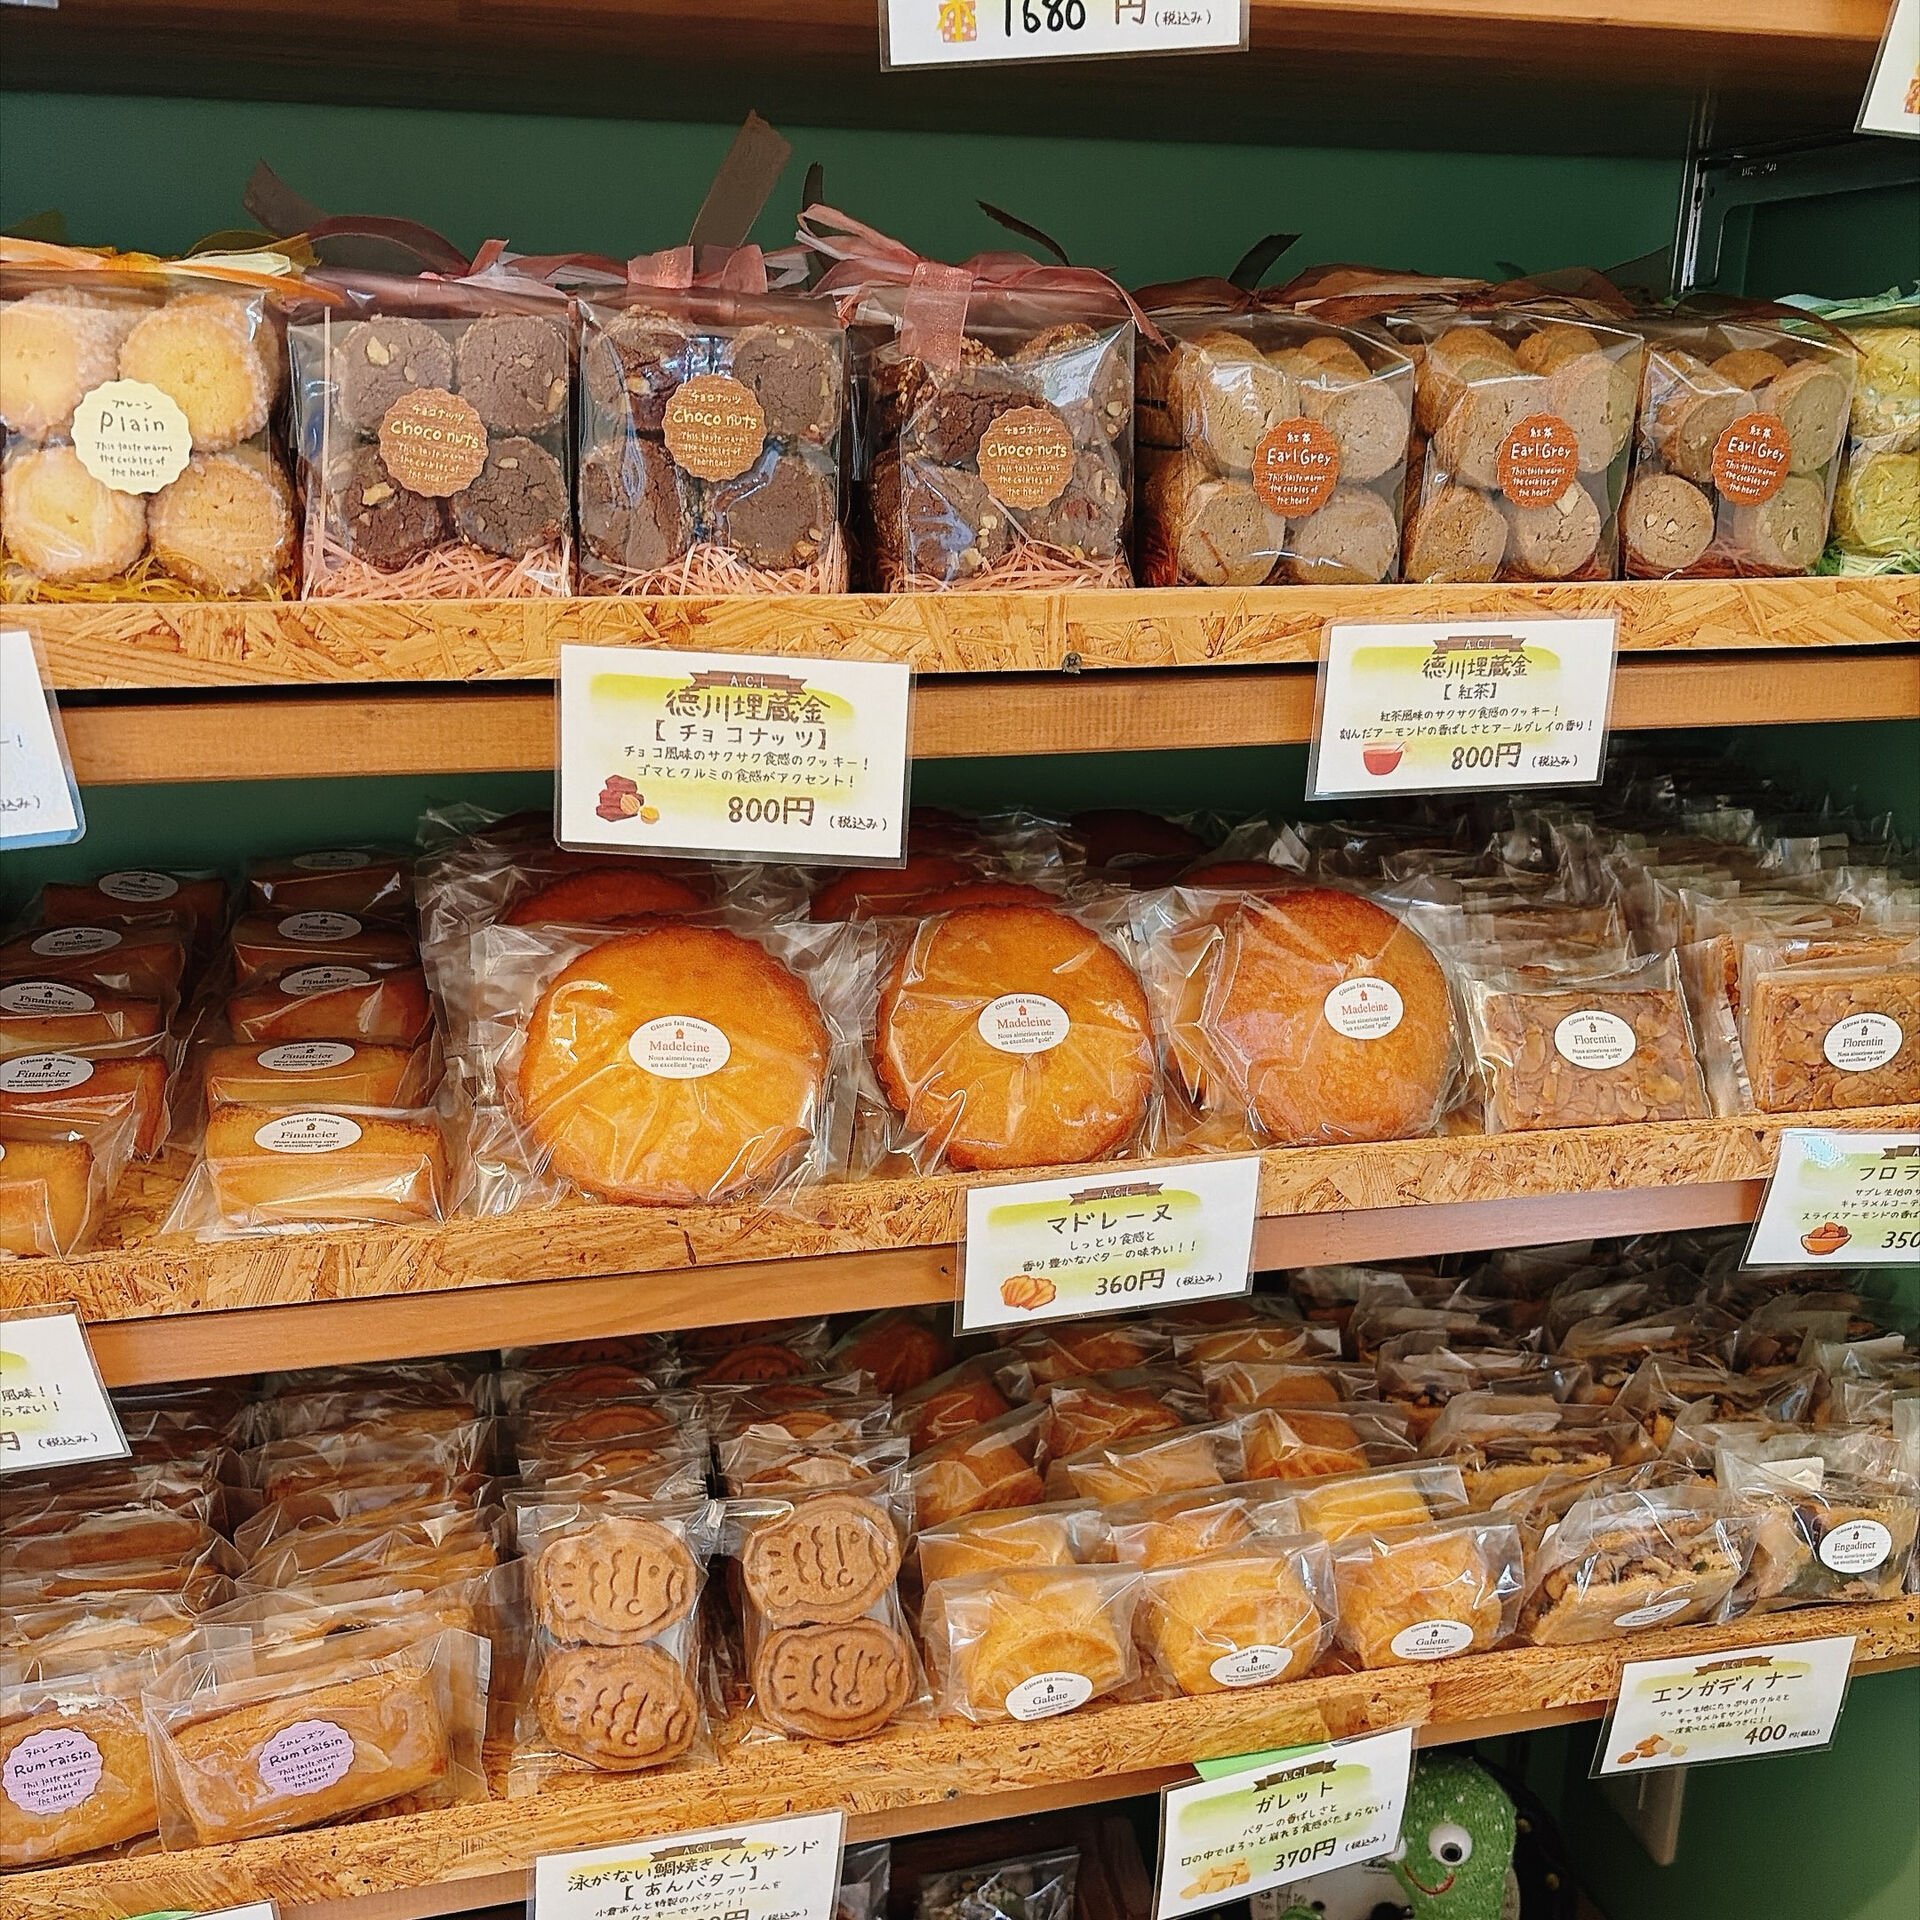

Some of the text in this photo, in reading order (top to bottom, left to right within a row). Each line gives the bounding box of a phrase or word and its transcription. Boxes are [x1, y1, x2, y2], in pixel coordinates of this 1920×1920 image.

[1003, 0, 1086, 37] 1680
[1154, 10, 1212, 27] (税込み)
[112, 399, 153, 410] プレーン
[691, 391, 741, 404] チョコナッツ
[100, 411, 164, 434] Plain
[412, 404, 465, 422] チョコナッツ
[726, 414, 757, 430] nuts
[1004, 423, 1053, 435] チョコナッツ
[1287, 432, 1311, 444] 紅茶
[447, 432, 479, 449] nuts
[1037, 442, 1067, 458] nuts
[1727, 436, 1785, 463] Earl Grey
[1267, 448, 1331, 467] Earl Grey
[1511, 443, 1571, 460] Earl Grey
[1422, 654, 1532, 680] 徳川埋蔵金
[1443, 682, 1498, 701] 【紅茶】
[665, 689, 831, 725] 徳川埋蔵金
[1380, 706, 1560, 723] 紅茶風味のサクサク食感のクッキー！
[656, 719, 827, 751] 【チョコナッツ】
[624, 745, 870, 771] チョコ風味のサクサク食感のクッキー！
[1451, 742, 1579, 771] 800円 (税込み)
[636, 765, 855, 788] ゴマとクルミの食感がアクセント！
[728, 796, 889, 832] 800円 (税込み)
[1341, 1002, 1389, 1016] Madeleine
[997, 1017, 1052, 1030] Madeleine
[649, 1040, 710, 1053] Madeleine
[1574, 1034, 1617, 1045] Florentin
[1842, 1037, 1884, 1048] Florentin
[15, 1070, 71, 1078] Financier
[280, 1131, 338, 1139] Financier
[1047, 1203, 1173, 1236] マドレーヌ
[1070, 1231, 1156, 1251] しっとり食感と
[1022, 1240, 1198, 1273] 香り豊かなバターの味わい！！
[1095, 1268, 1223, 1297] 360円 (税込み)
[38, 1433, 98, 1449] (税込み)
[1834, 1541, 1876, 1553] Engadiner
[1416, 1638, 1449, 1646] Galette
[1236, 1664, 1270, 1673] Galette
[1651, 1671, 1803, 1704] エンガディナー
[1032, 1693, 1068, 1705] Galette
[279, 1730, 326, 1750] ラムレーズン
[1744, 1724, 1787, 1746] 400
[25, 1740, 74, 1758] ラムレーズン
[269, 1738, 343, 1768] Rum raisin
[14, 1751, 91, 1778] Rum raisin
[1255, 1781, 1334, 1814] ガレット
[1243, 1803, 1338, 1836] バターの香ばしさと
[1273, 1838, 1336, 1873] 370円
[1345, 1834, 1387, 1852] (税込み)
[568, 1840, 819, 1893] 泳がない鯛焼きくんサンド
[625, 1866, 758, 1901] 【あんバター】
[595, 1881, 782, 1918] 小倉あんと特製のバタークリームを
